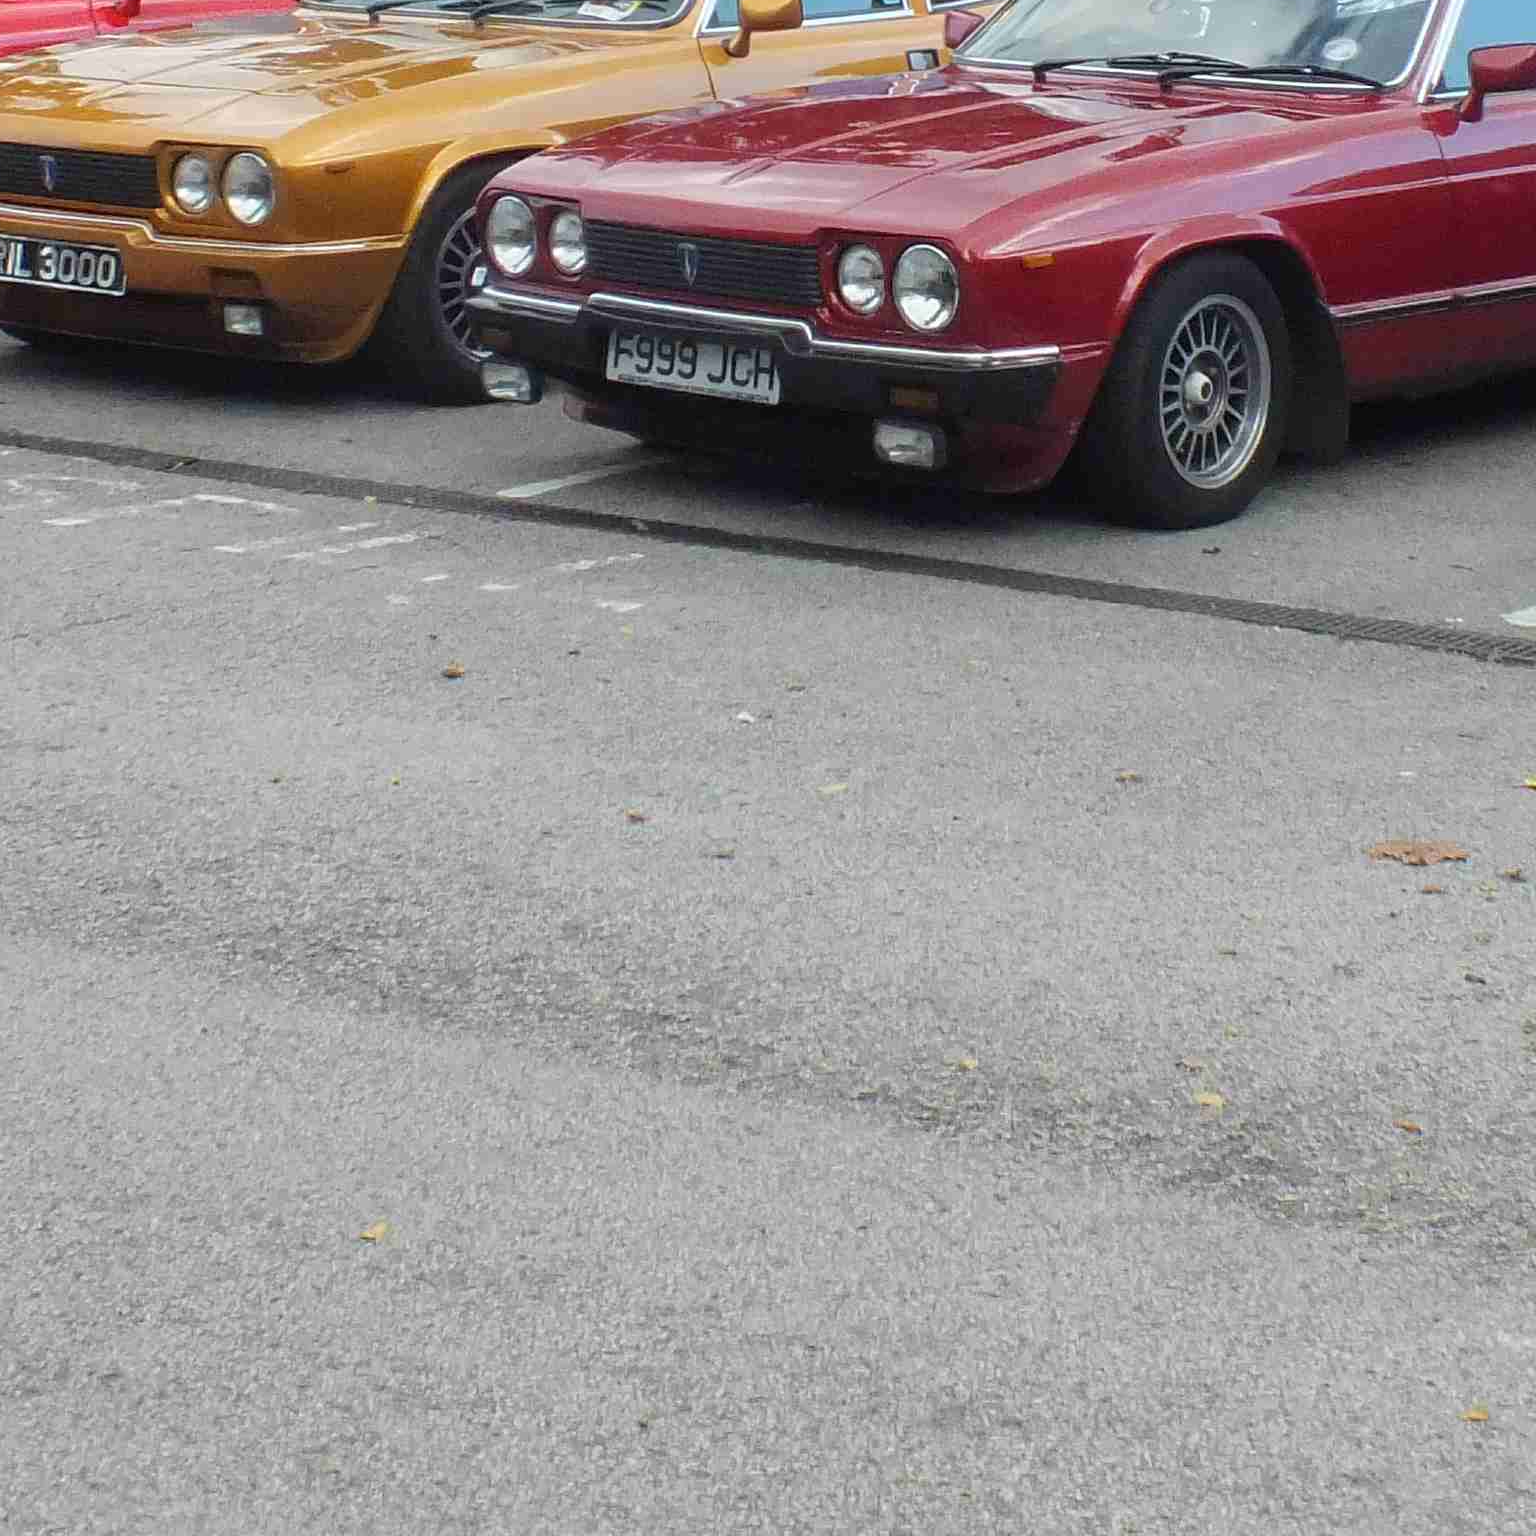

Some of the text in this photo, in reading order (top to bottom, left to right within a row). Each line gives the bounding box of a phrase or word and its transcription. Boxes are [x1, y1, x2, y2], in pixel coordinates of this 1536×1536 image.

[39, 245, 116, 288] 3000
[613, 333, 699, 379] F999
[706, 343, 774, 391] JCH
